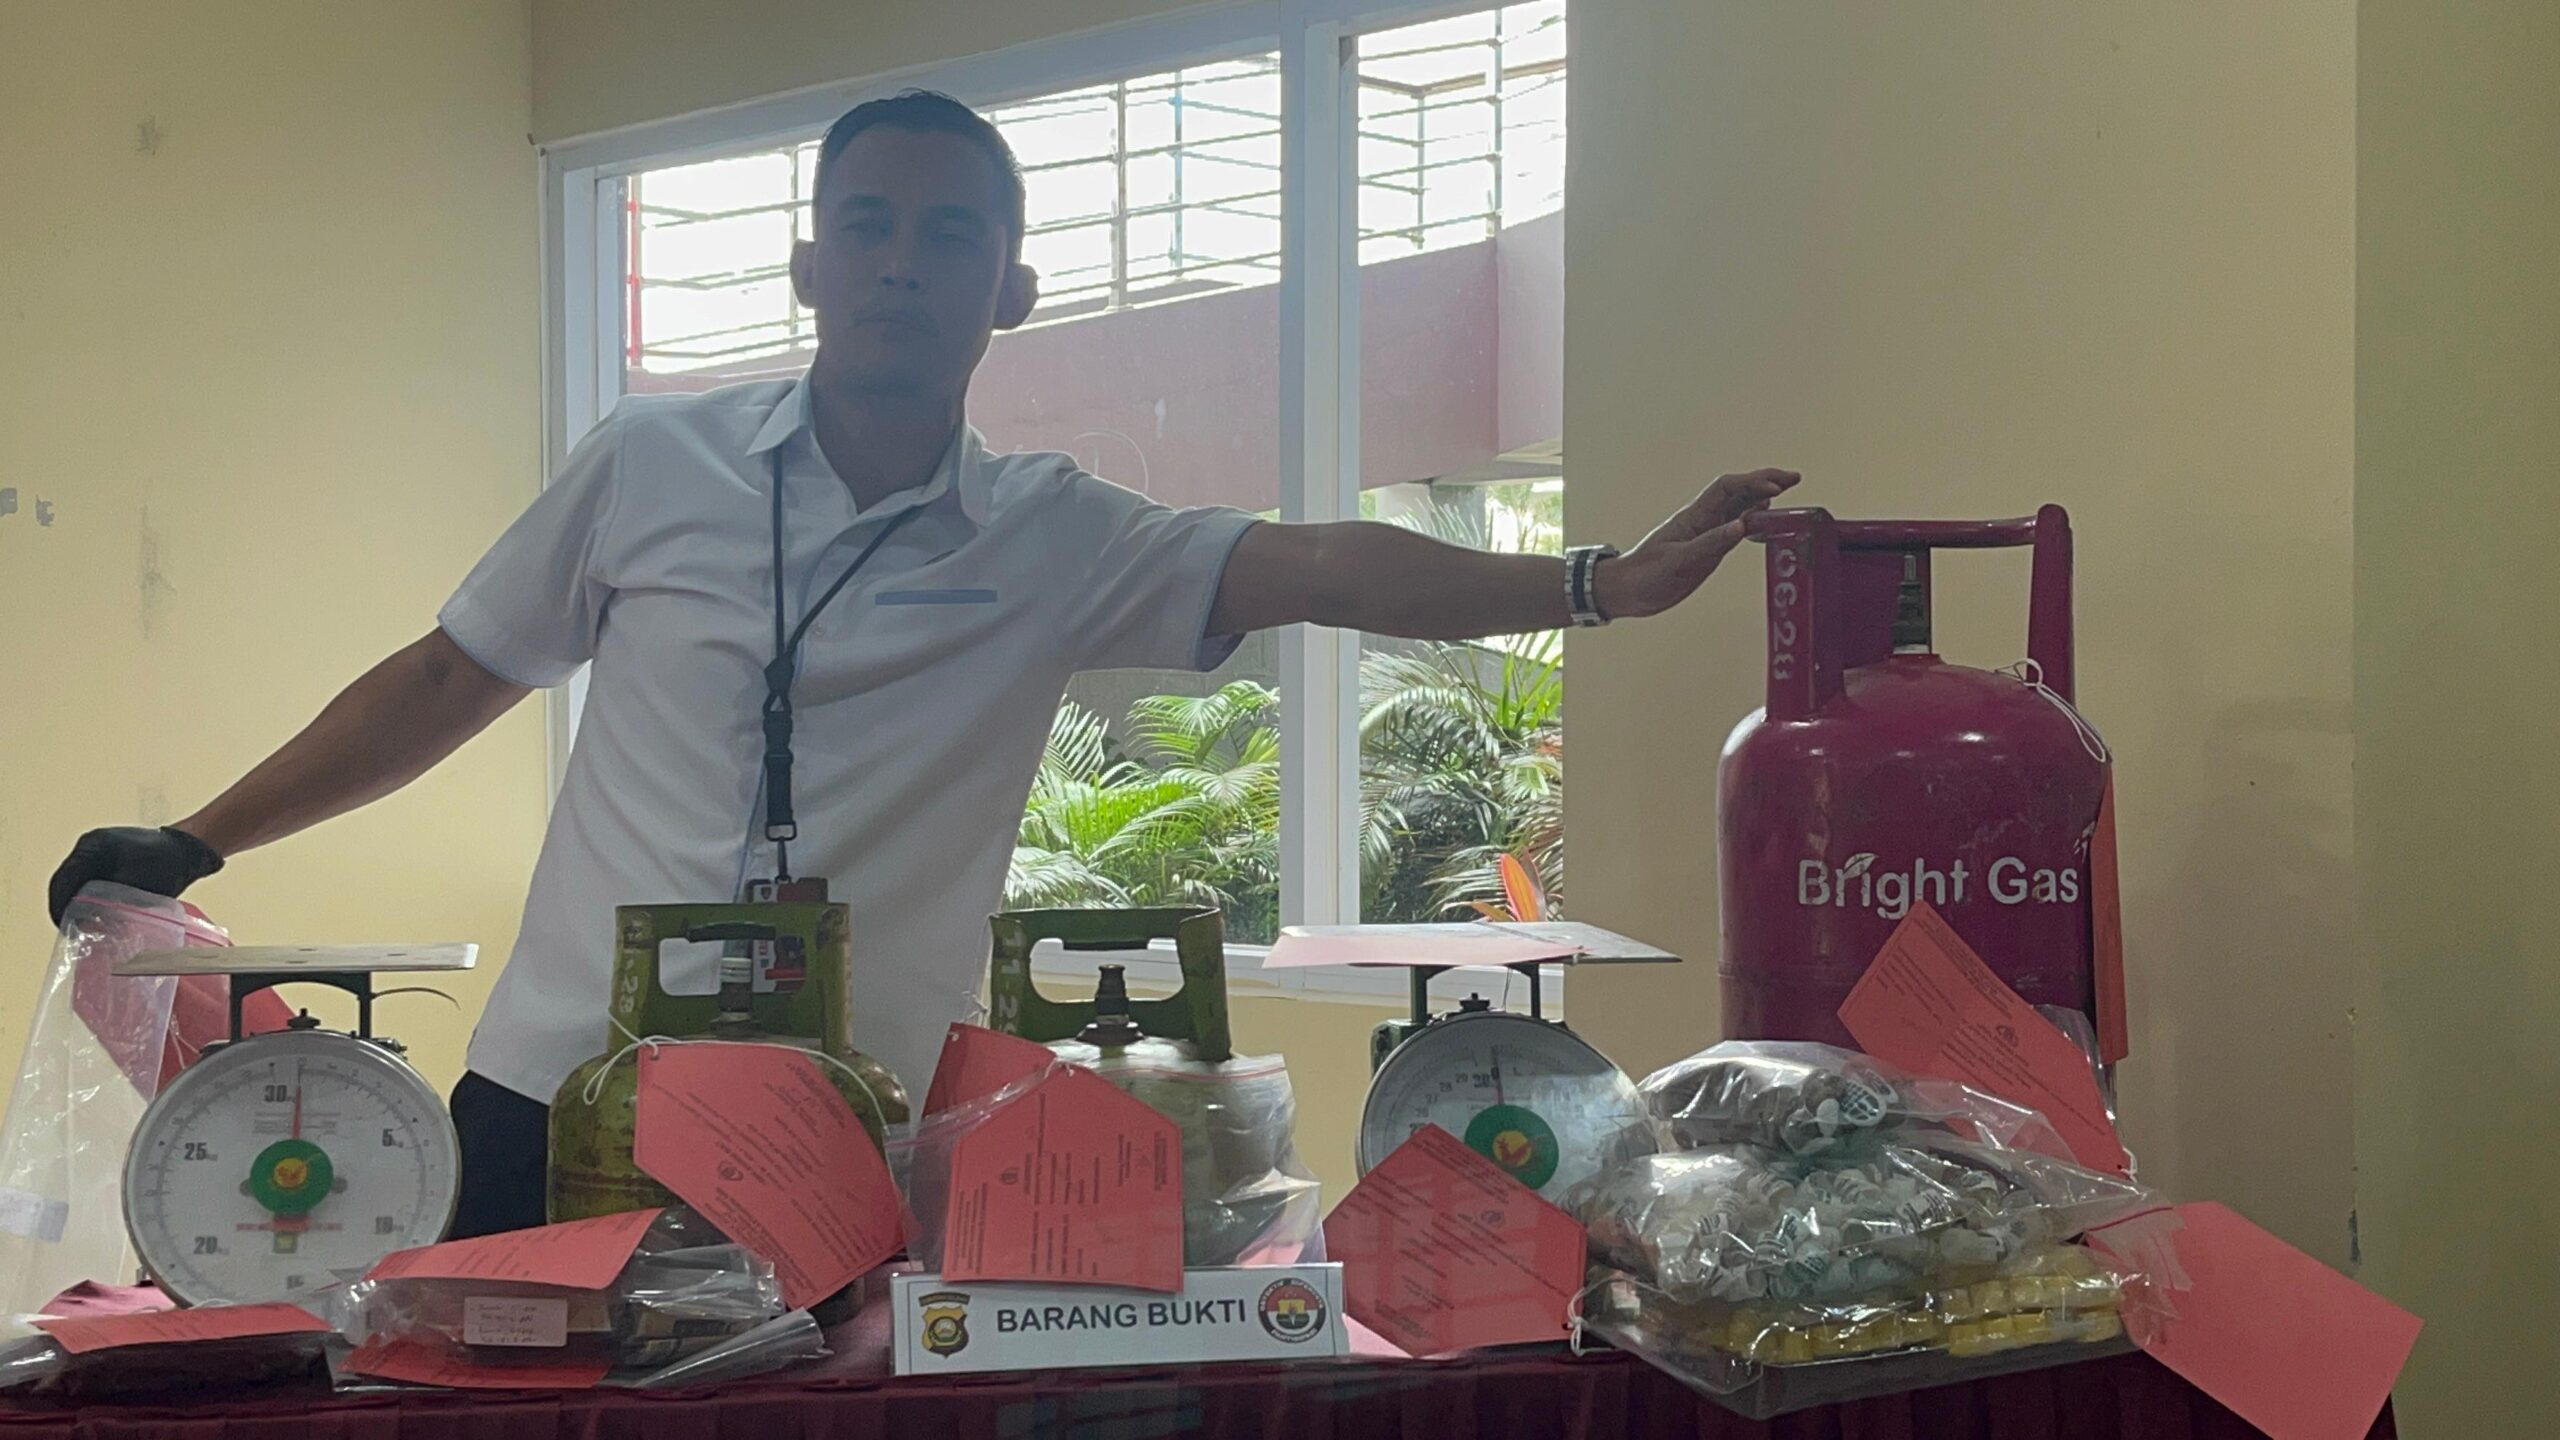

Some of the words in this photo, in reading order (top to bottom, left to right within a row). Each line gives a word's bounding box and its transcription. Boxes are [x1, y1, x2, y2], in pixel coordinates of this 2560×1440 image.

[1798, 853, 1970, 920] Bright
[1987, 856, 2080, 905] Gas
[997, 1304, 1138, 1333] BARANG
[1148, 1299, 1246, 1326] BUKTI
